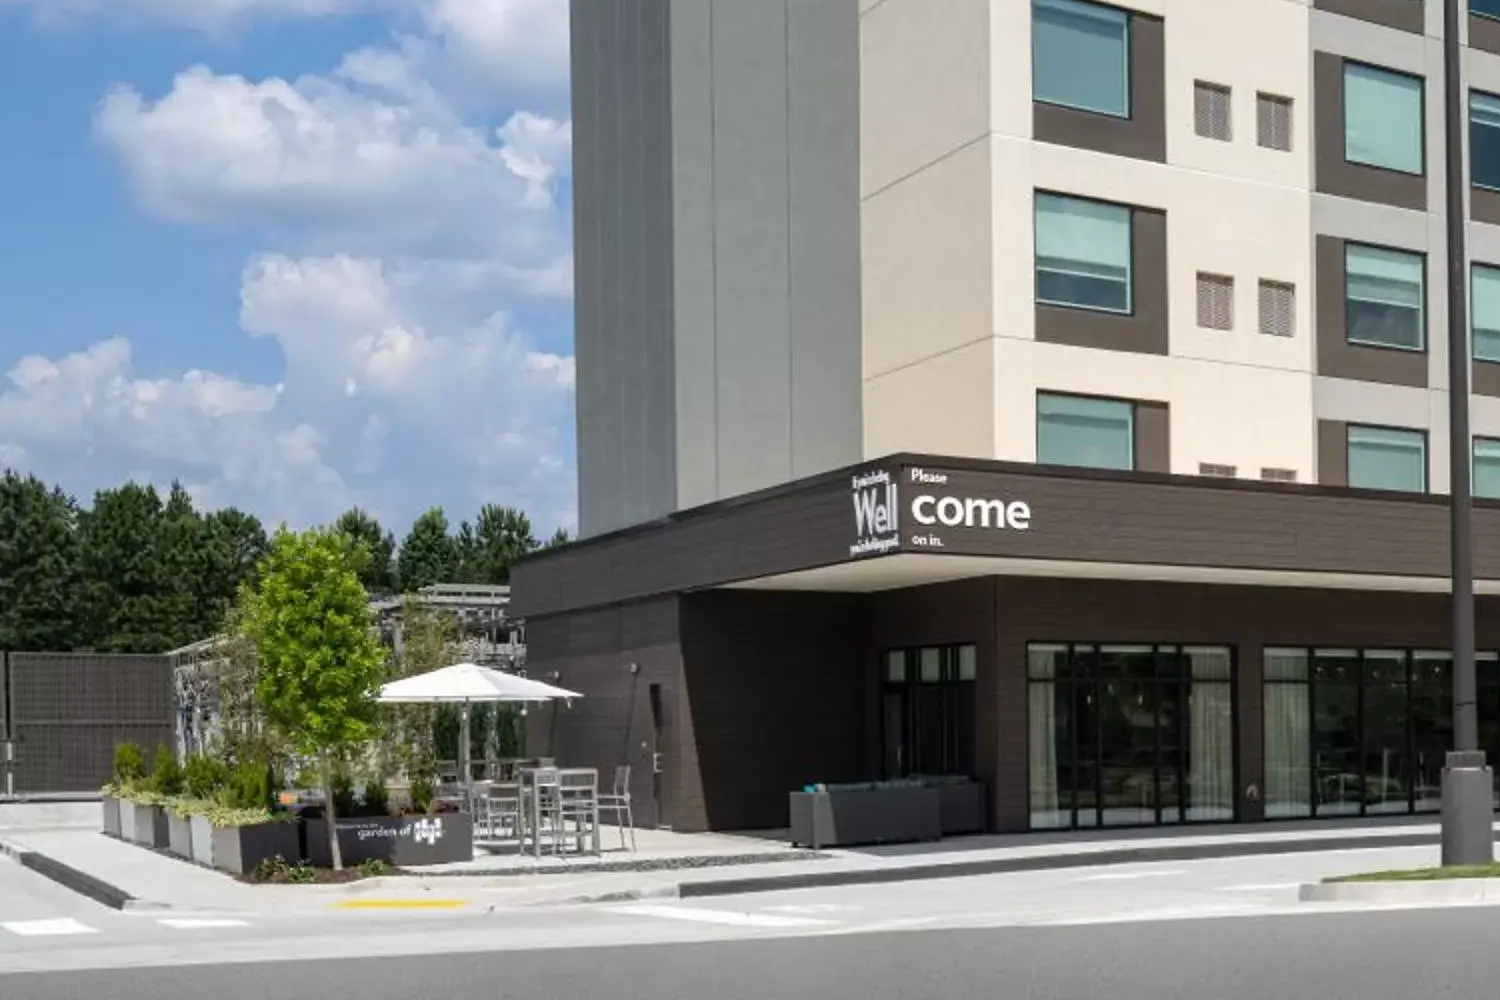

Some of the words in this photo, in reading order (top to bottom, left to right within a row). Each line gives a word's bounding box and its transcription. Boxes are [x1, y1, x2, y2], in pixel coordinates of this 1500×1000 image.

[911, 468, 948, 484] Please
[852, 483, 898, 537] Well
[911, 495, 1031, 529] come
[911, 535, 928, 546] on
